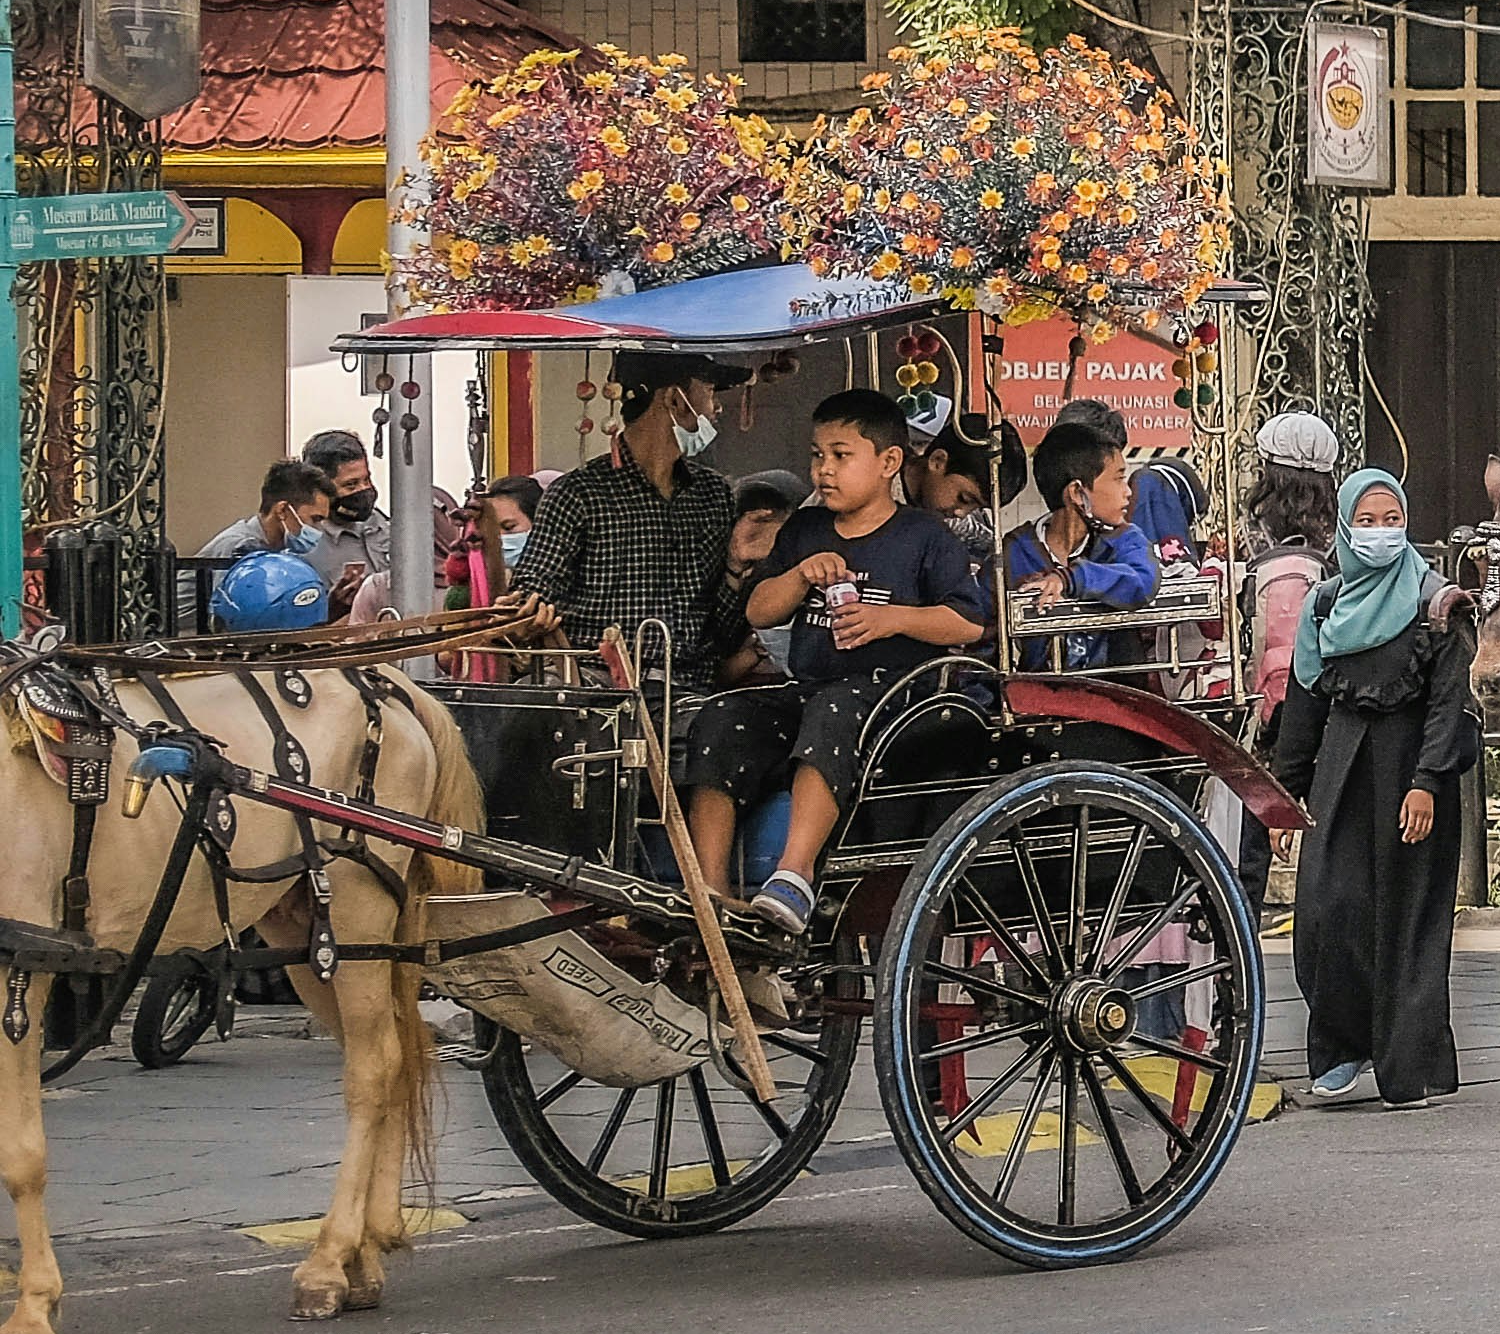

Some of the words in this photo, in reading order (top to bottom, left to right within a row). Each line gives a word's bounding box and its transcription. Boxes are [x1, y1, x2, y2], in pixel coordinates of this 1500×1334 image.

[43, 205, 88, 225] Museum
[90, 202, 119, 222] Bank
[121, 199, 167, 220] Mandiri
[1087, 361, 1167, 381] PAJAK
[1034, 394, 1086, 409] BEL
[557, 958, 597, 984] FEED
